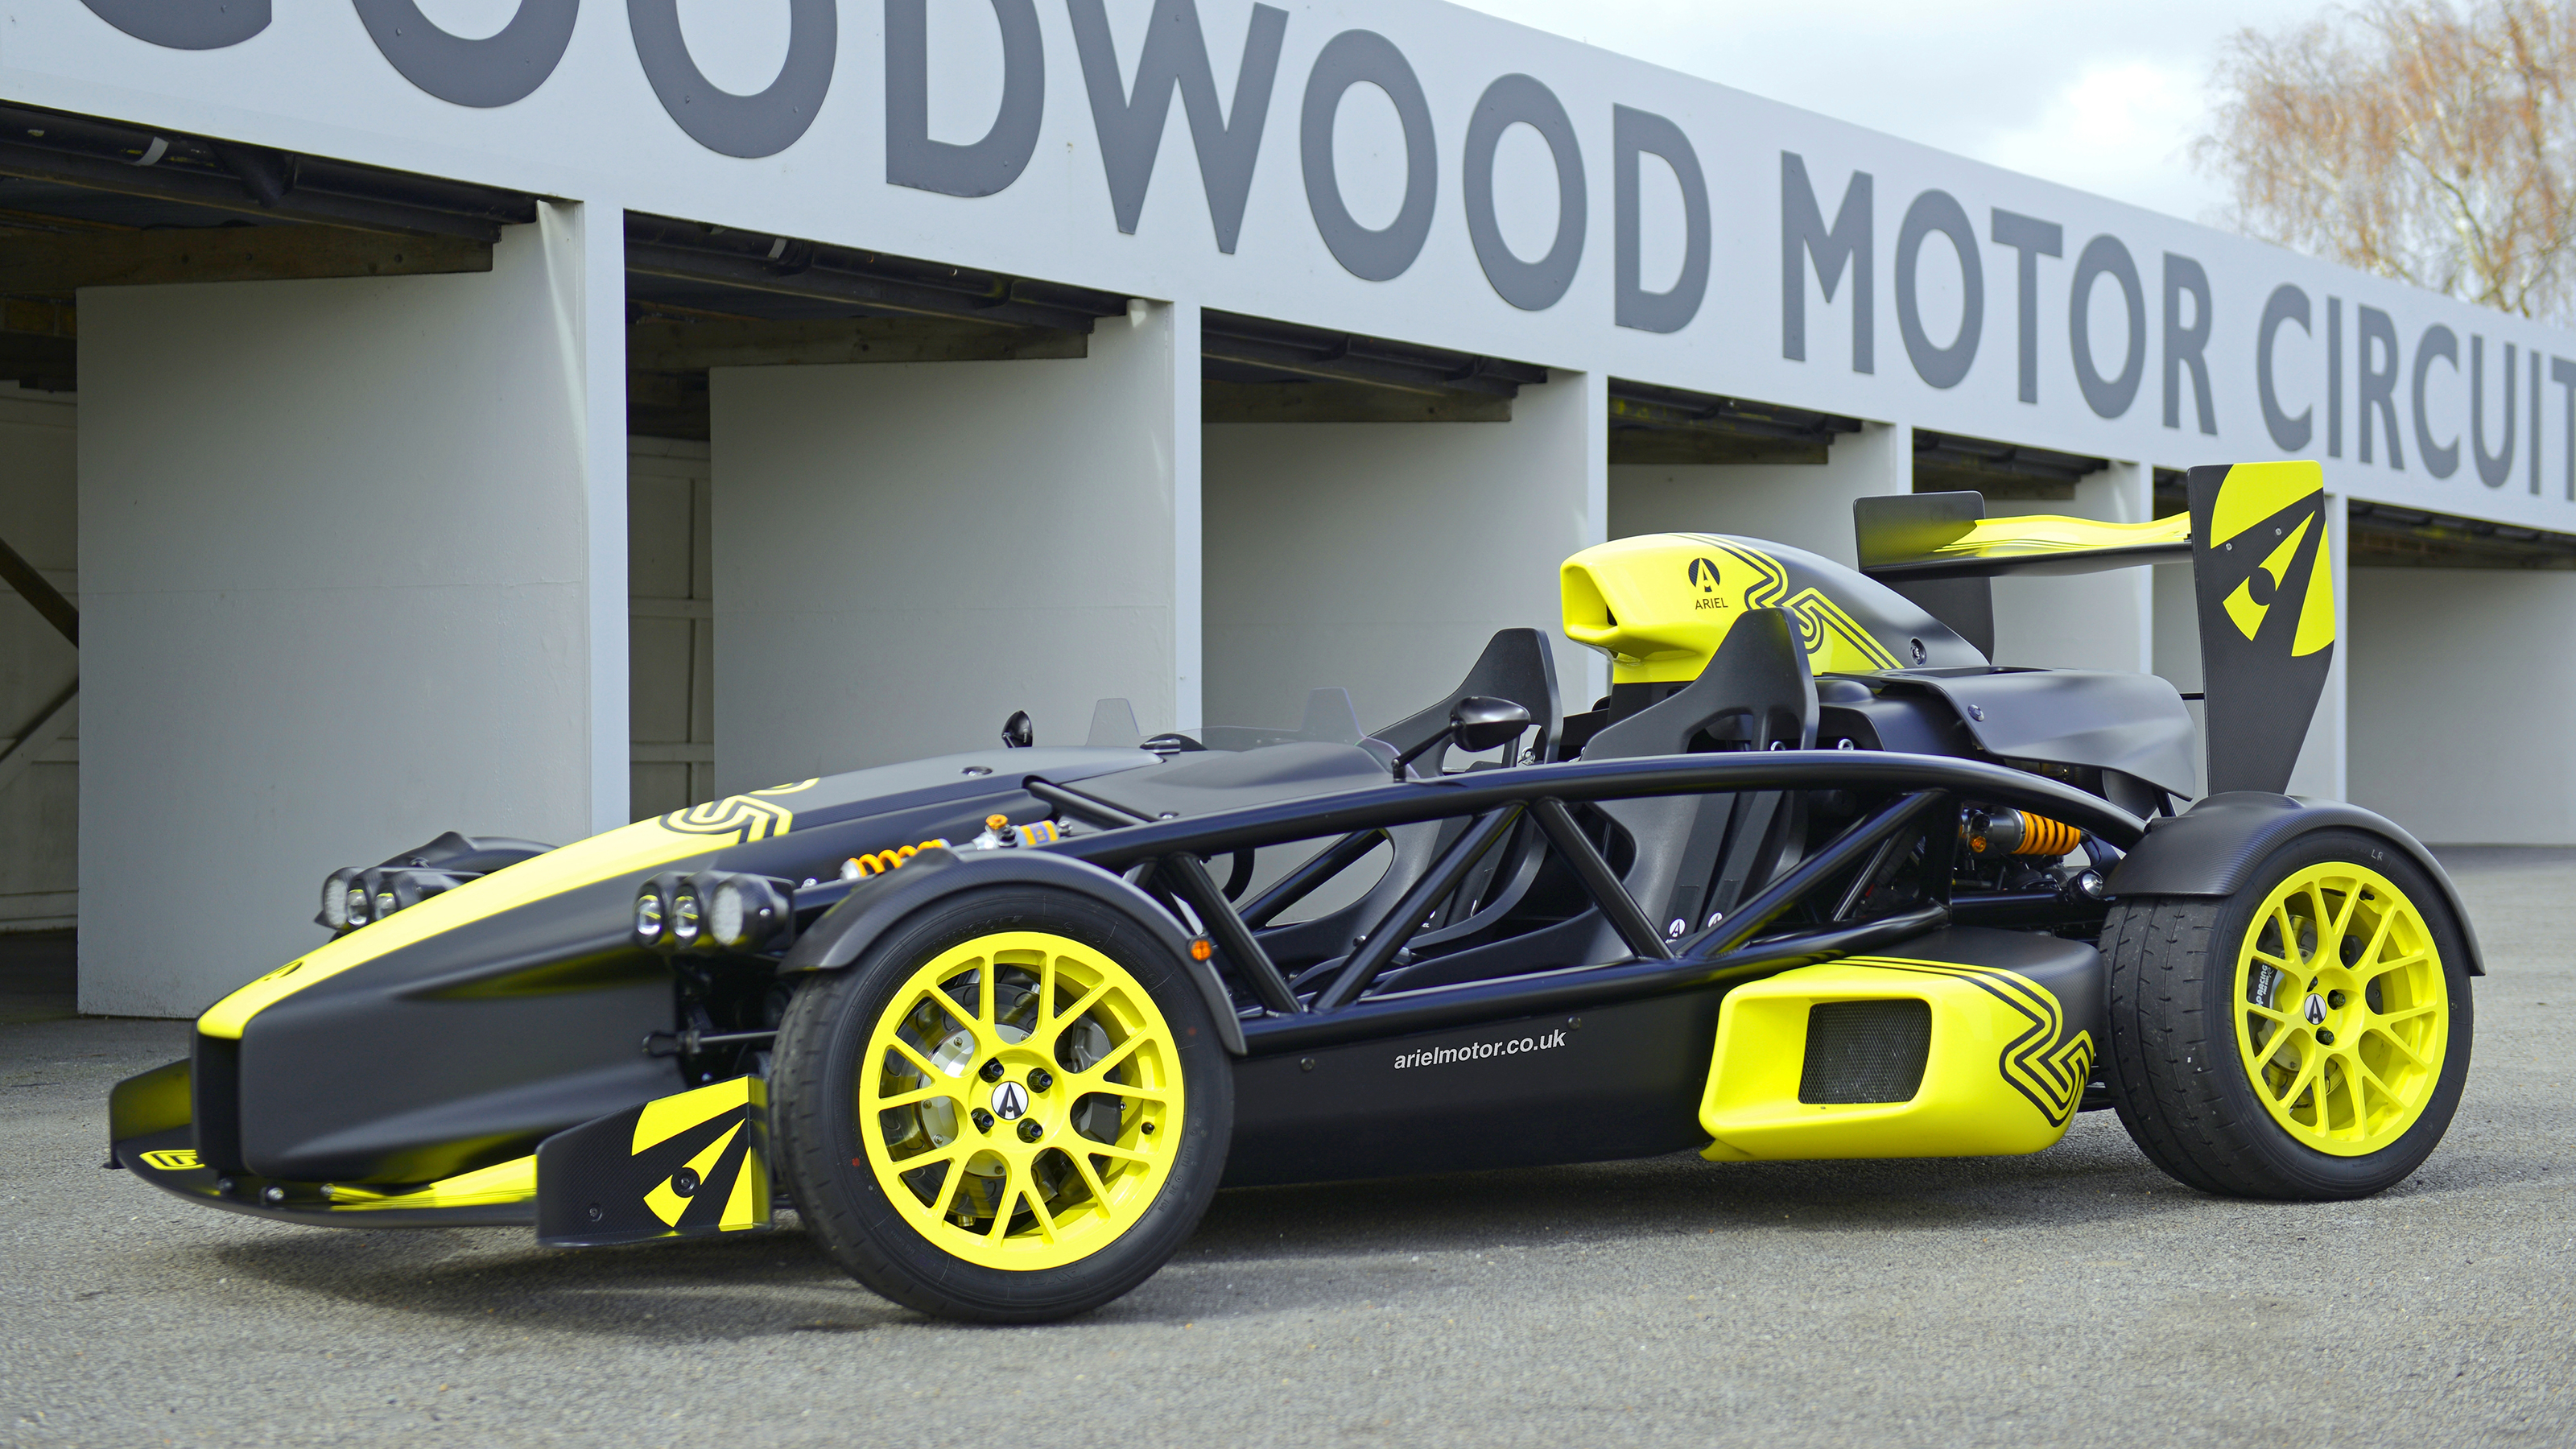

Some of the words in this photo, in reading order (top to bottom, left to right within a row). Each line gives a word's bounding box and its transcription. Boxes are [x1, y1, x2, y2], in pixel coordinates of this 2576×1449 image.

[79, 0, 1711, 333] ODWOOD
[1781, 150, 2218, 436] MOTOR
[2256, 283, 2576, 502] CIRCUIT
[1695, 597, 1728, 610] ARIEL
[2371, 848, 2384, 861] LR
[2256, 964, 2268, 997] RACING
[1393, 1029, 1567, 1069] arielmotor.co.uk
